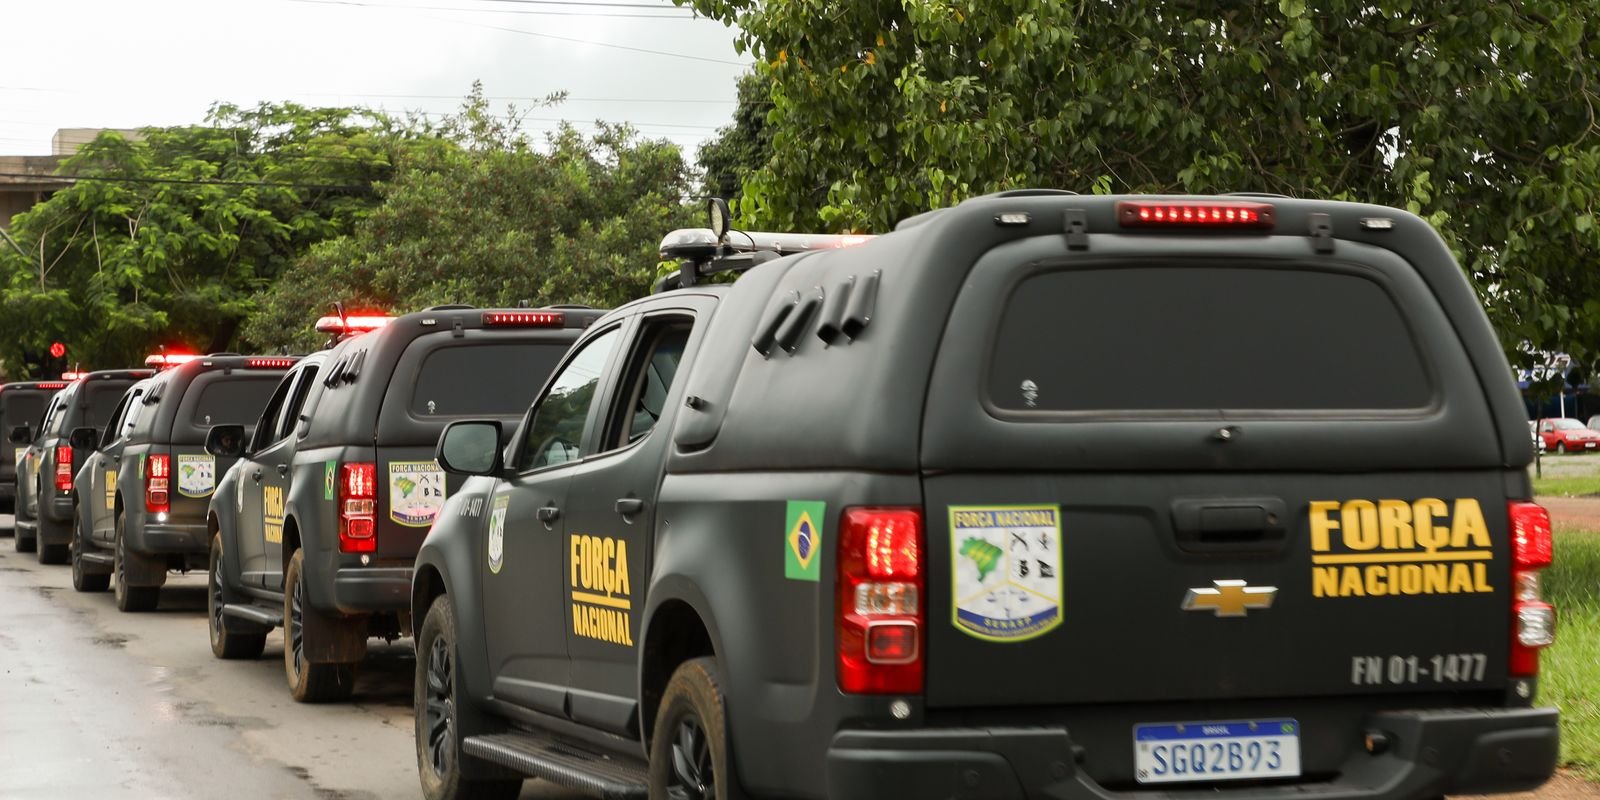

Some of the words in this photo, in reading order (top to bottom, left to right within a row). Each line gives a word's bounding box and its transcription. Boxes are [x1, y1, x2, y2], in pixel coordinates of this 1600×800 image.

[413, 464, 439, 472] NACIONA
[995, 510, 1055, 527] NACIONAL
[1309, 497, 1492, 553] FORÇA
[571, 534, 631, 597] FORÇA
[1312, 563, 1494, 598] NACIONAL
[572, 603, 633, 647] NACIONAL
[1352, 656, 1383, 685] FN
[1388, 653, 1487, 685] 01-1477
[1152, 740, 1282, 776] SGQ2B93
